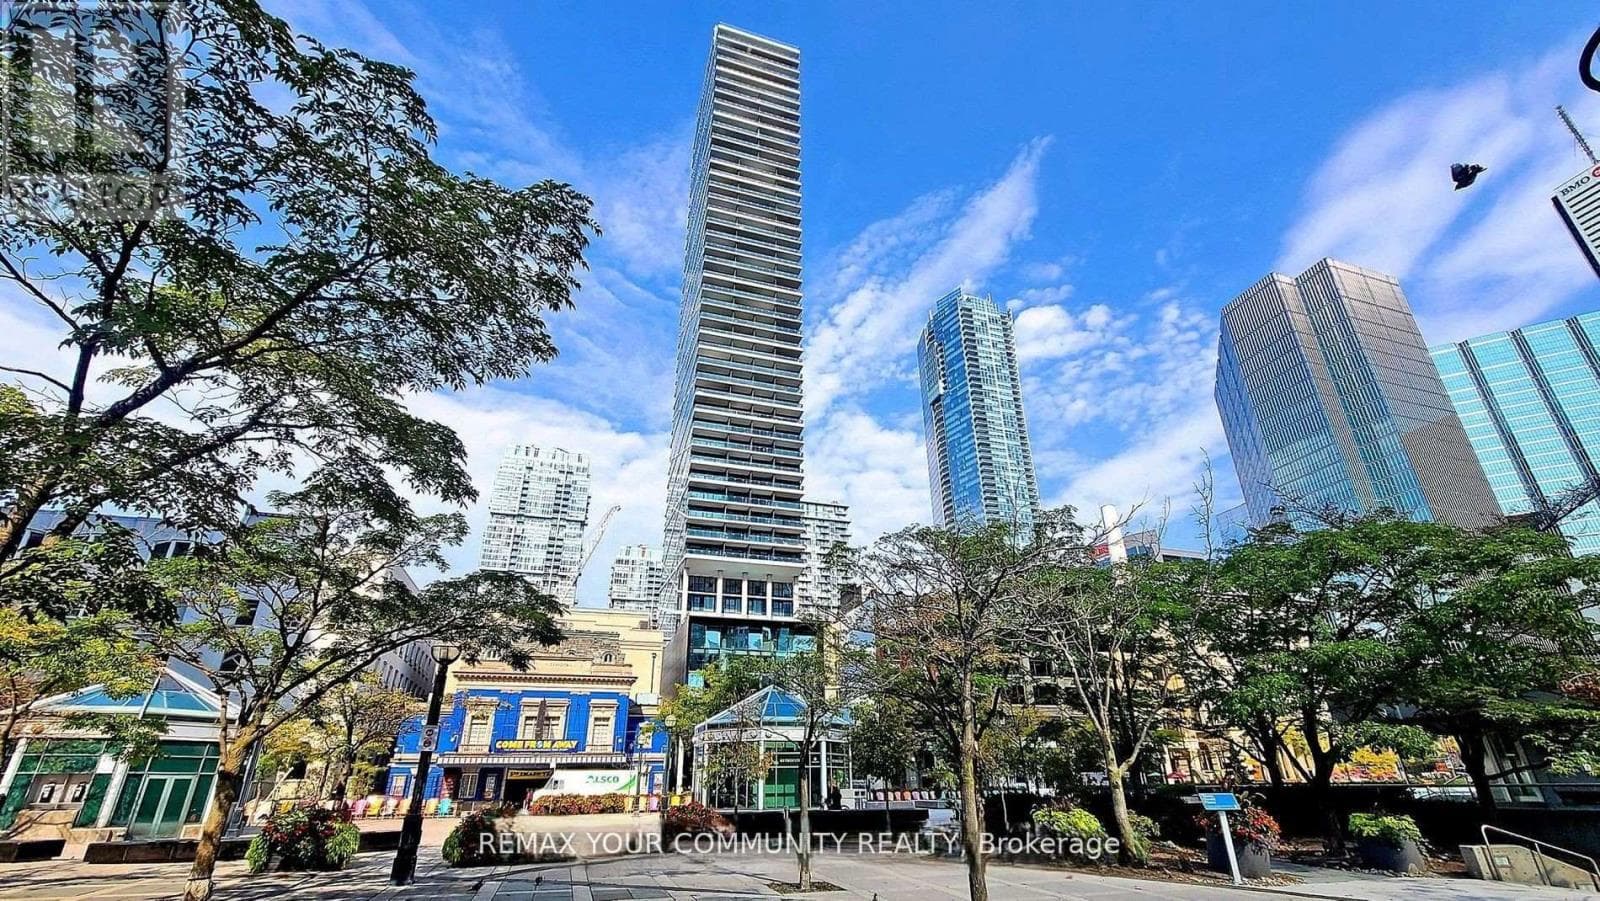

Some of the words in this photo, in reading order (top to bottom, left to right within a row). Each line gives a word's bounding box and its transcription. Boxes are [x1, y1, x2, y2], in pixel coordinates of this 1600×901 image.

[1560, 176, 1590, 196] BMO
[496, 741, 524, 749] COME
[525, 741, 552, 749] FROM
[552, 741, 578, 749] AWAY
